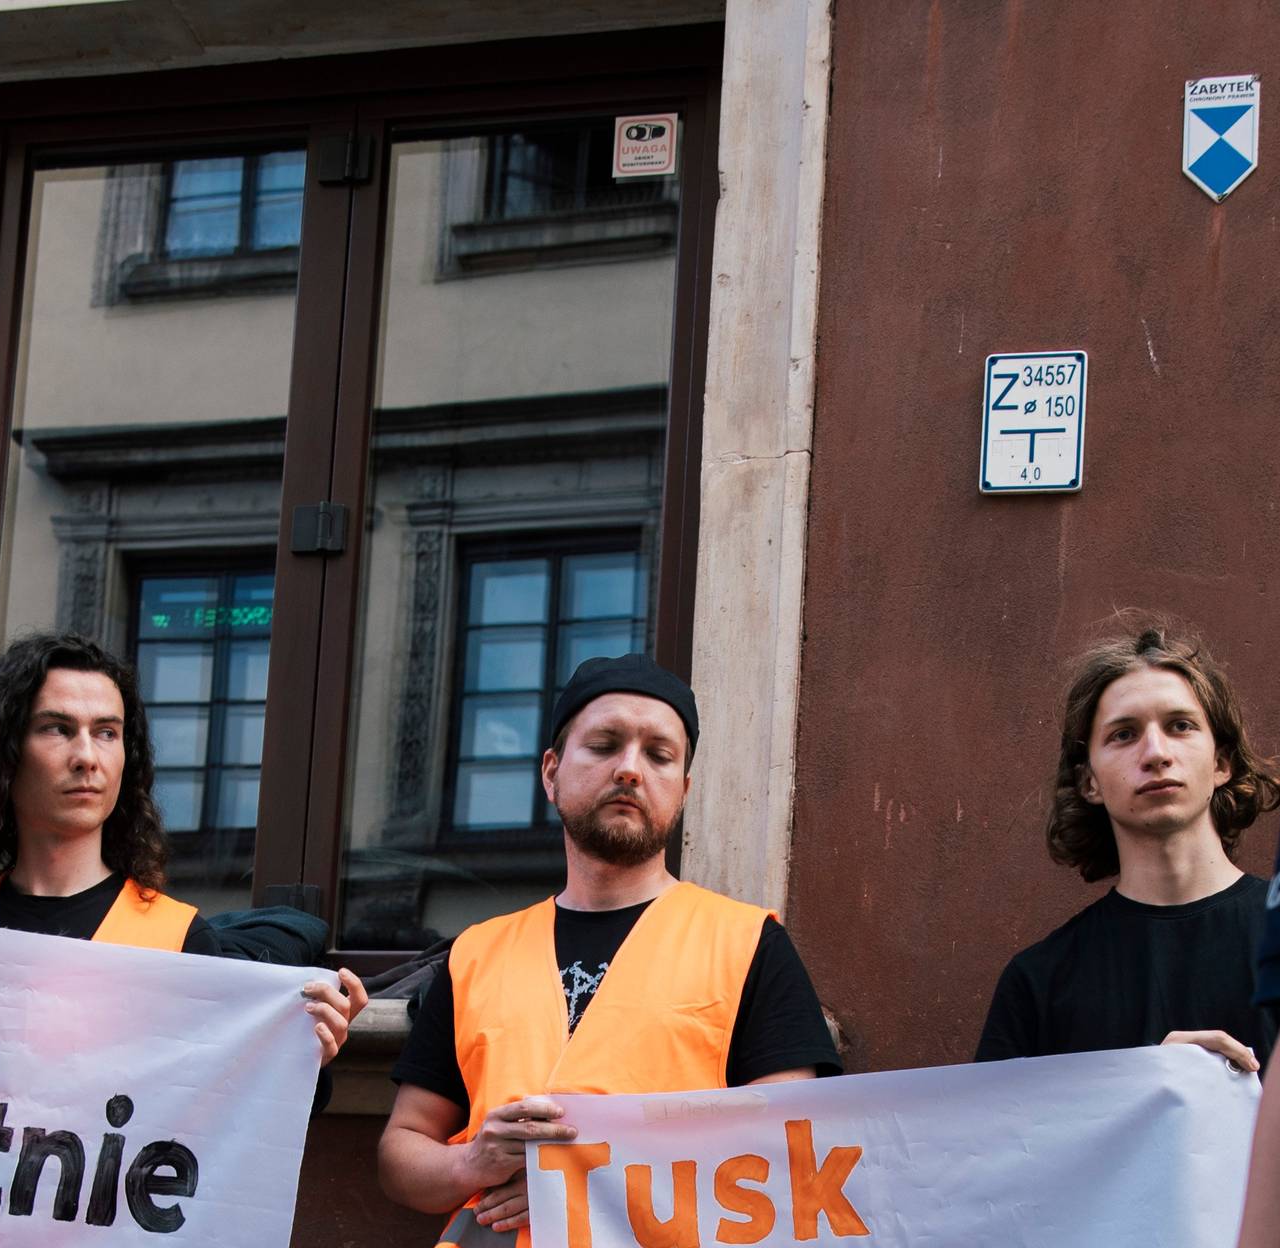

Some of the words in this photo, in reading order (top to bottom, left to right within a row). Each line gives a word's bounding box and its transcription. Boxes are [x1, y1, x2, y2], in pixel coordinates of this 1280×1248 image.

[1190, 81, 1255, 96] ZABYTEK
[622, 144, 667, 154] UWAGA
[992, 373, 1019, 411] Z
[1023, 364, 1077, 387] 34557
[1045, 395, 1076, 417] 150
